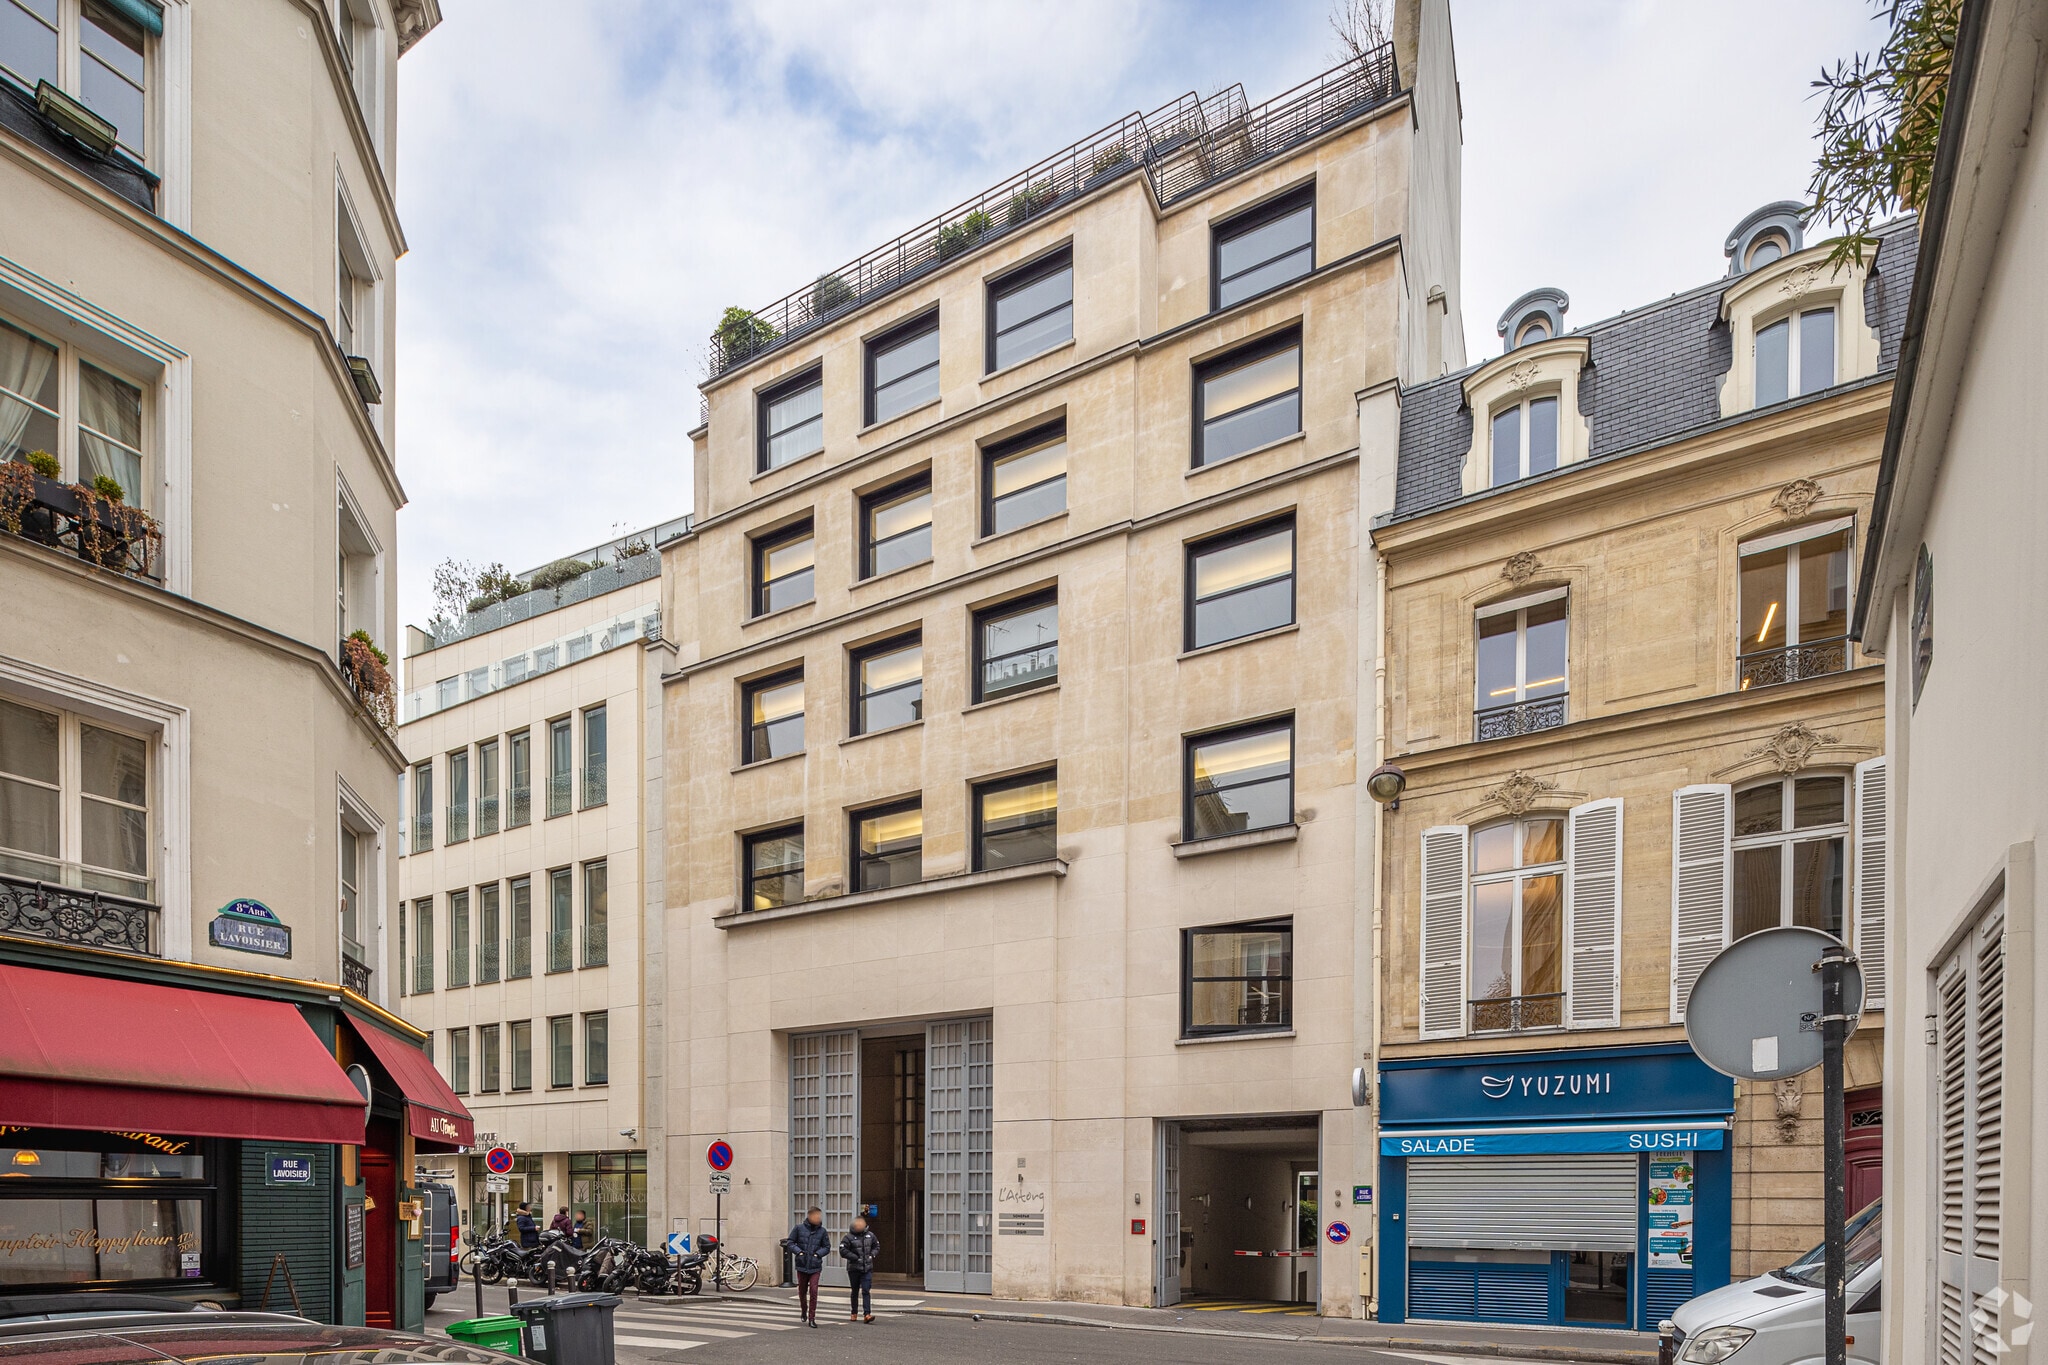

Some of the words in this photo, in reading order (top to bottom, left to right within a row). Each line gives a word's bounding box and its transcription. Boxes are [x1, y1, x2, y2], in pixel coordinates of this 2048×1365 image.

[238, 925, 264, 936] RUE
[1521, 1073, 1610, 1097] YUZUMI
[430, 1117, 440, 1132] AU
[475, 1133, 497, 1142] ANQUE
[1629, 1132, 1698, 1149] SUSHI
[1401, 1138, 1475, 1153] SALADE
[283, 1160, 298, 1168] RUE
[273, 1170, 308, 1178] LAVOISIER
[593, 1181, 626, 1192] BANQUE
[63, 1228, 130, 1254] Happy
[133, 1229, 173, 1246] hour
